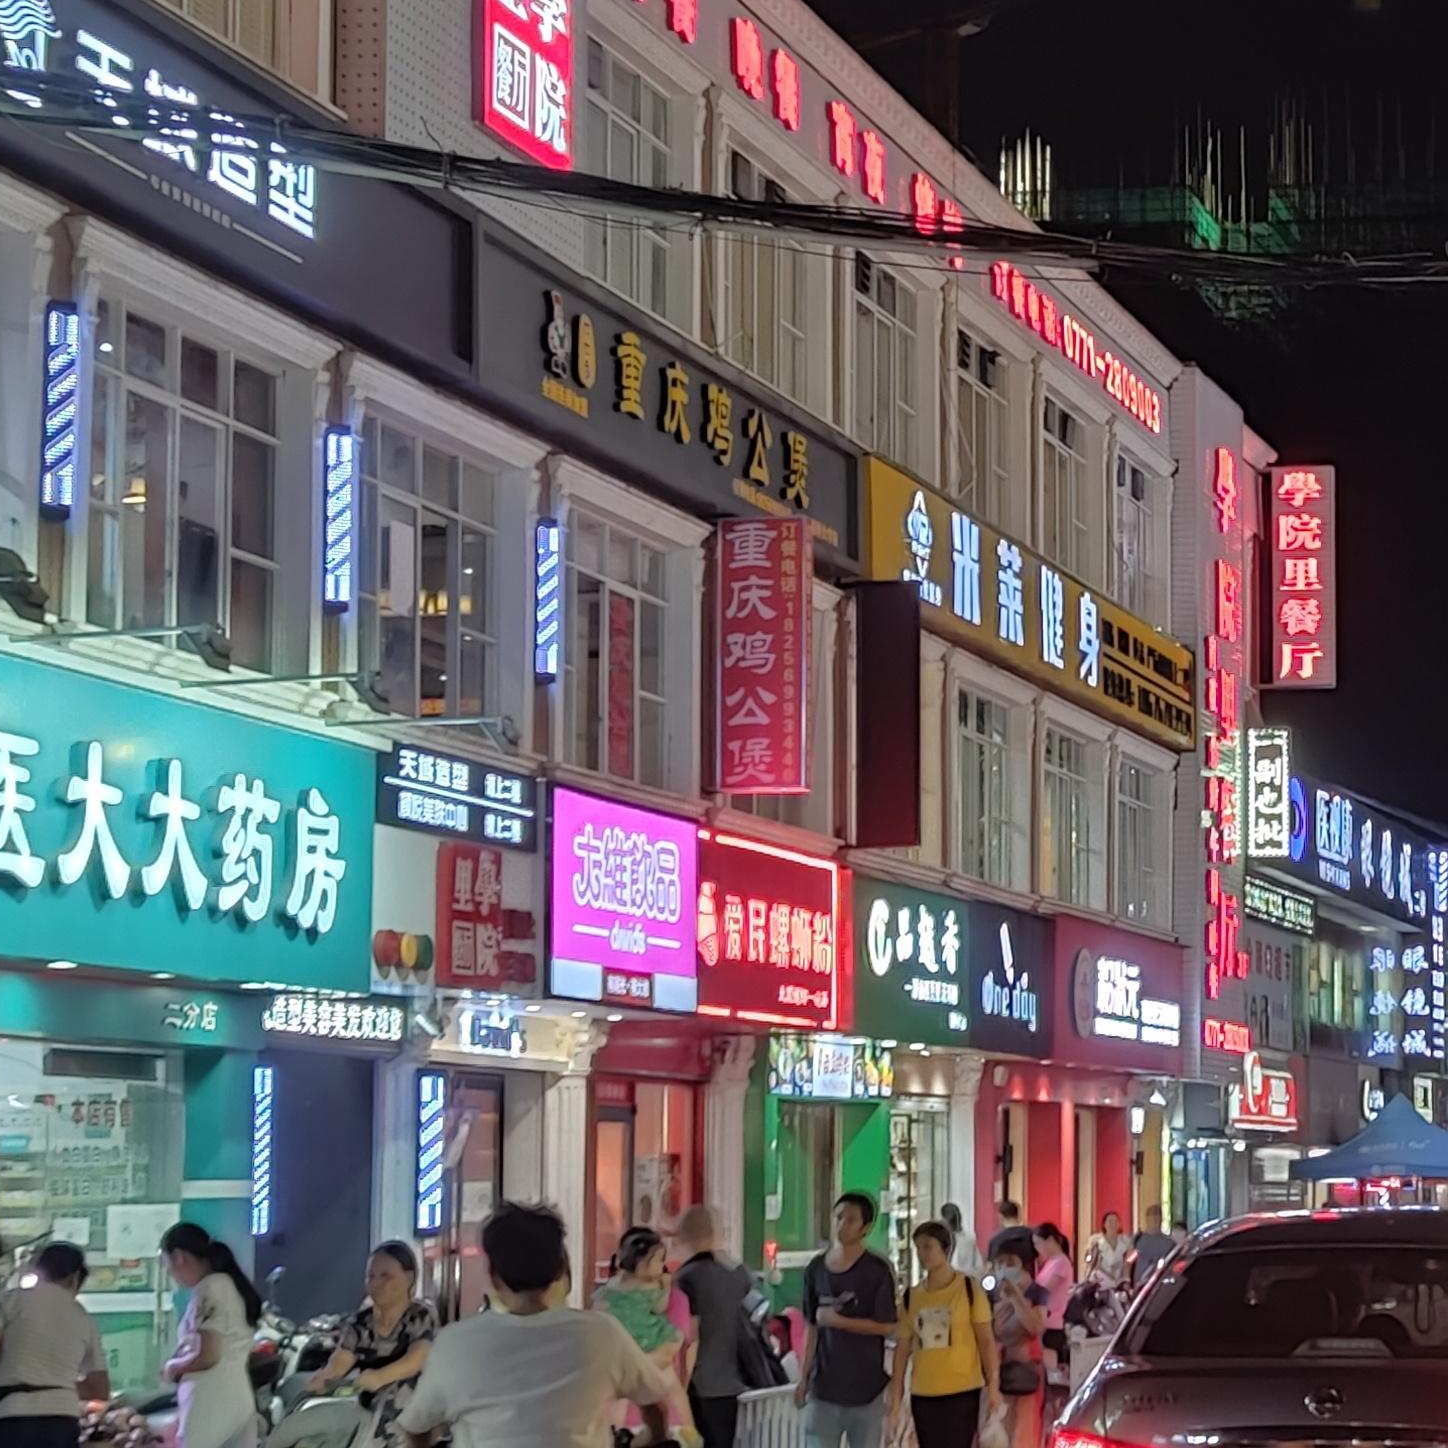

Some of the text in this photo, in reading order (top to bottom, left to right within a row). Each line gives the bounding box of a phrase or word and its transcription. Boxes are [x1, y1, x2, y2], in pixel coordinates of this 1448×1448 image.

[724, 522, 779, 784] 重庆鸡公煲
[163, 1001, 219, 1032] 二分店
